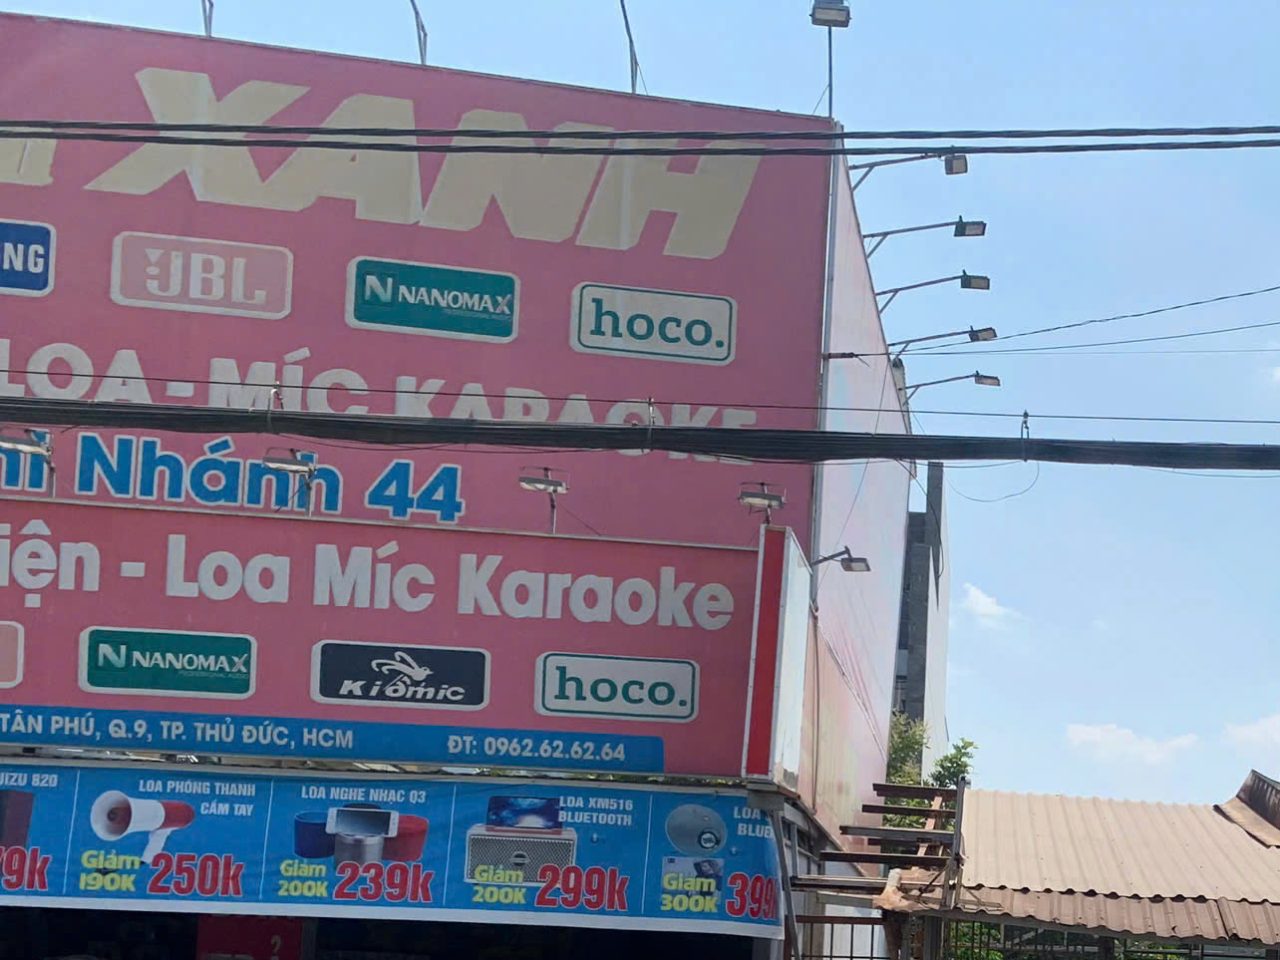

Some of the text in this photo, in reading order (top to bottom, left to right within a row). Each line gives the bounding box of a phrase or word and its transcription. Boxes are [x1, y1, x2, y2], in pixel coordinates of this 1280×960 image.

[84, 66, 767, 260] XANH
[148, 249, 269, 306] JBL
[398, 284, 513, 315] NANOMAX
[589, 297, 727, 350] hoco.
[75, 430, 342, 515] Nhánh
[364, 459, 465, 526] 44
[166, 533, 290, 605] Loa
[313, 542, 435, 614] Míc
[457, 553, 735, 631] Karaoke
[131, 650, 249, 674] NANOMAX
[554, 666, 689, 711] hoco.
[0, 711, 354, 750] TÂN PHÚ, Q.9, TP. THỦ ĐỨC, HCM
[447, 733, 626, 763] ĐT: 0962.62.62.64
[31, 772, 59, 788] 820
[138, 778, 164, 793] LOA
[214, 781, 256, 797] THANH
[301, 783, 327, 800] LOA
[330, 785, 366, 802] NGHE
[369, 787, 406, 805] NHẠC
[233, 803, 255, 818] TAY
[559, 794, 585, 810] LOA
[732, 805, 762, 822] LOA
[557, 810, 633, 828] BLUETOOTH
[146, 851, 245, 898] 250k
[277, 881, 329, 898] 200K
[332, 860, 435, 904] 239k
[535, 862, 631, 912] 299k
[472, 885, 527, 905] 200K
[659, 894, 719, 914] 300K
